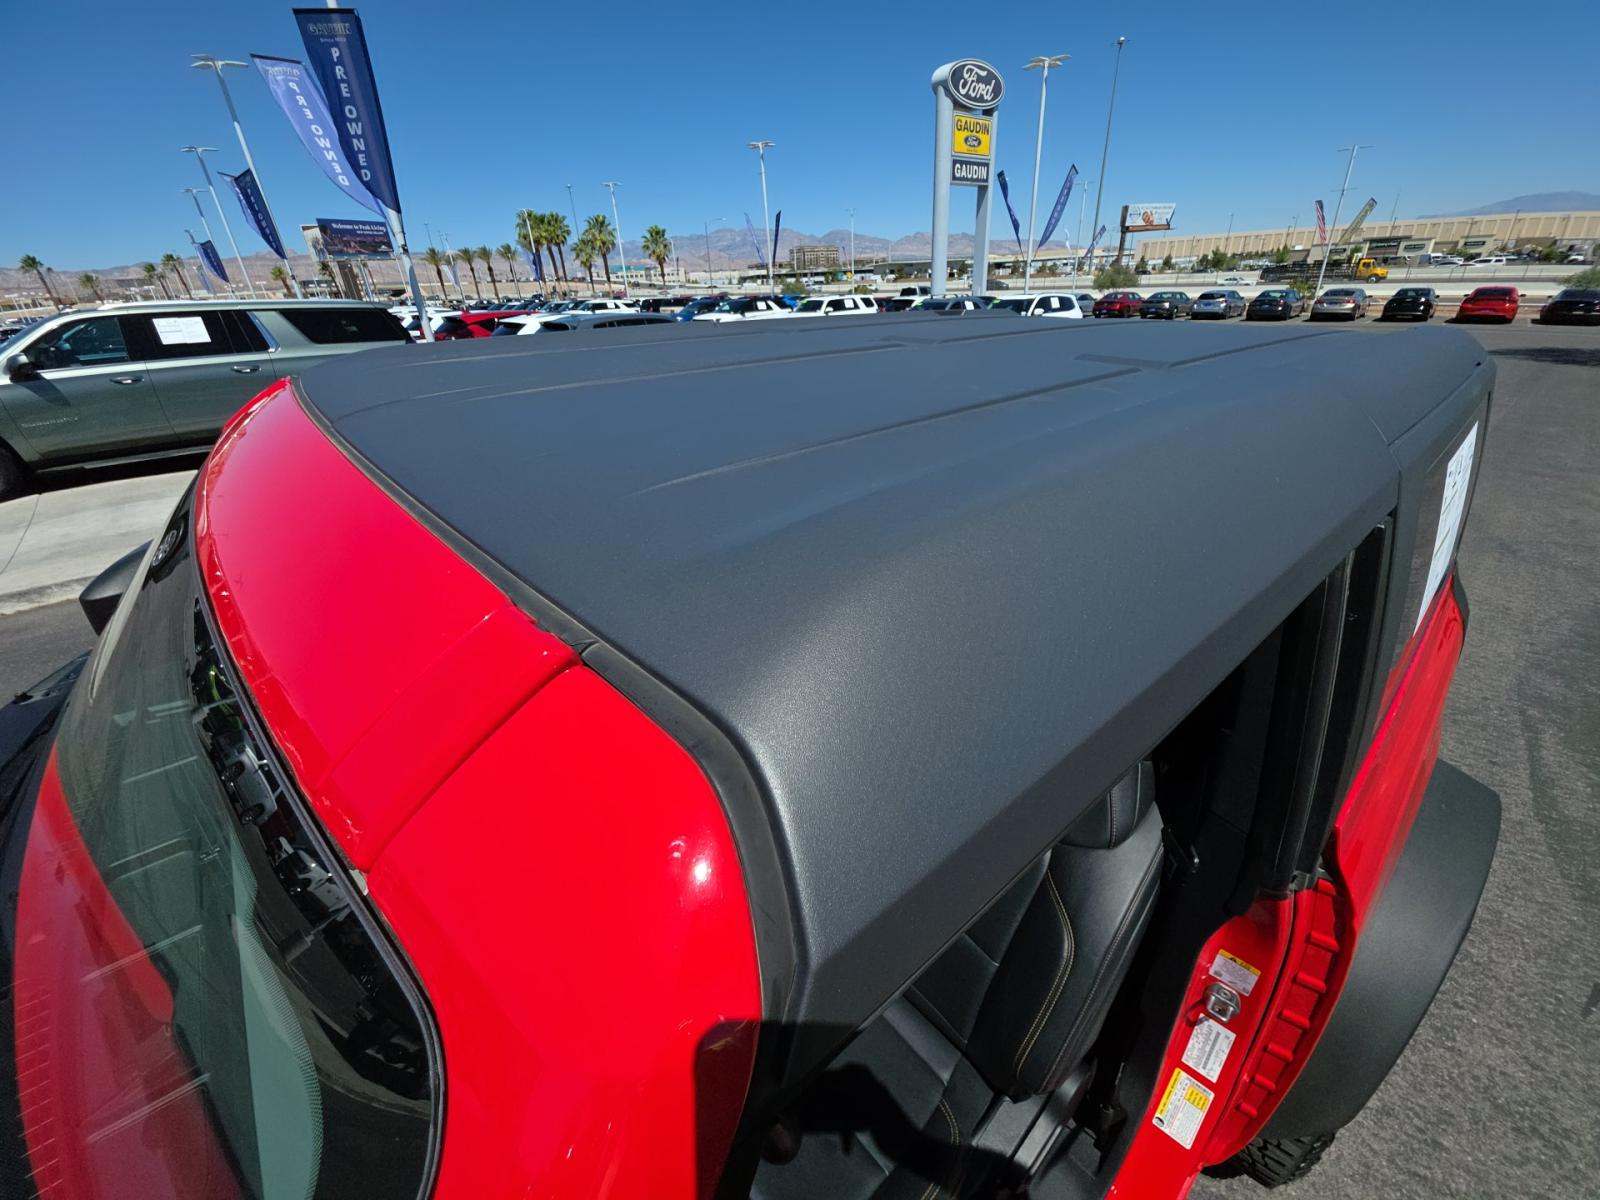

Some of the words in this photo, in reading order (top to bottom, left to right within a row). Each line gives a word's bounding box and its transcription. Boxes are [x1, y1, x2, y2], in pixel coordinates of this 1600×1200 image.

[958, 65, 996, 101] Ford
[331, 47, 350, 97] PRE
[345, 105, 371, 181] OWNED
[956, 118, 990, 135] GAUDIN
[954, 163, 987, 180] GAUDIN
